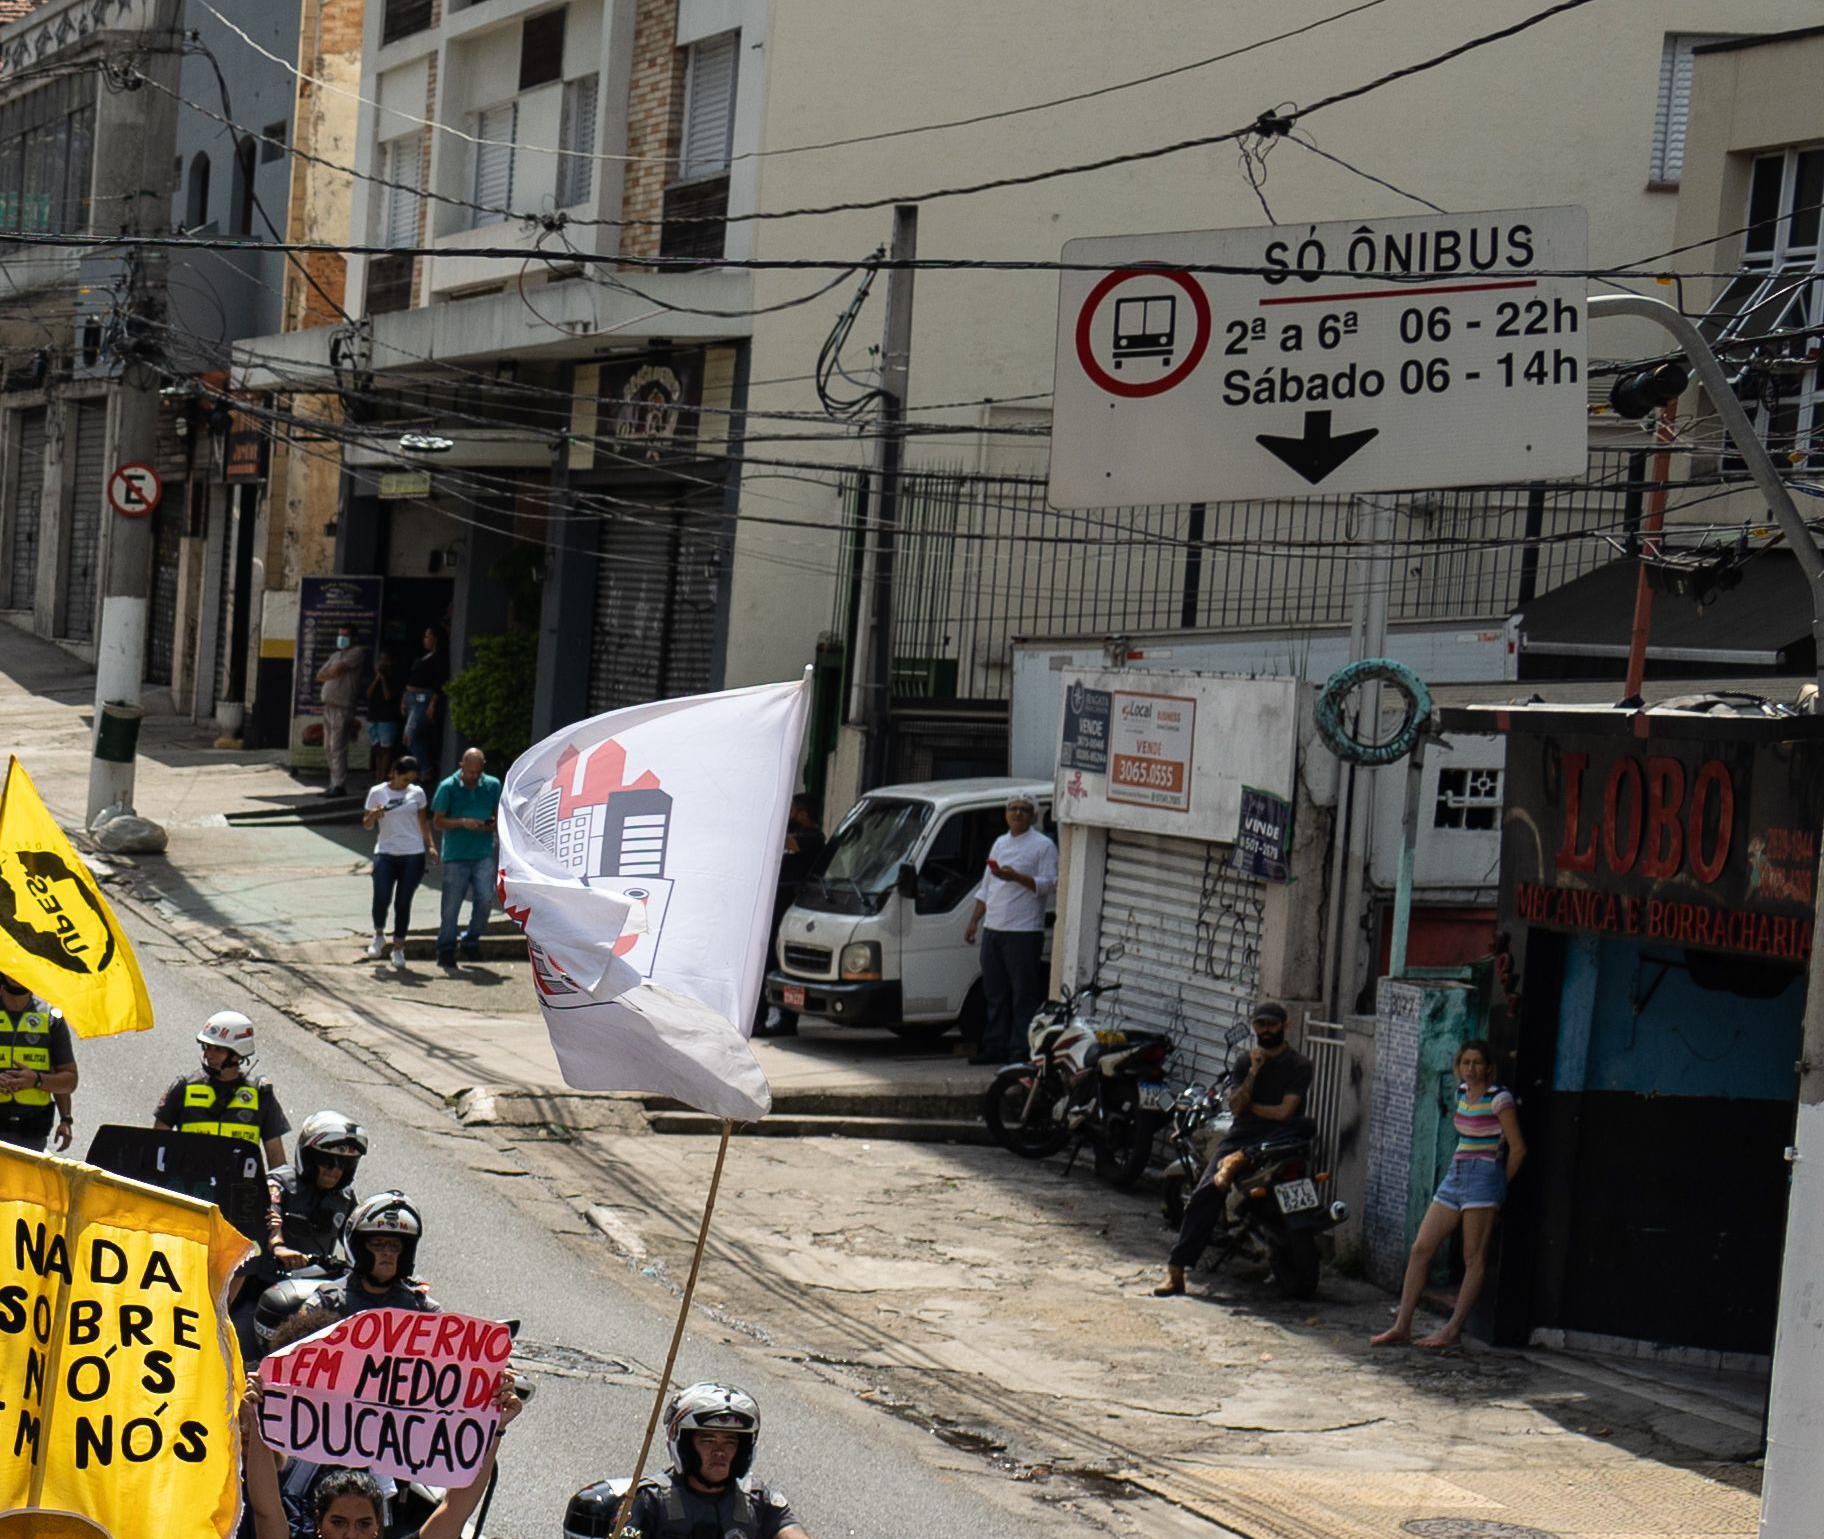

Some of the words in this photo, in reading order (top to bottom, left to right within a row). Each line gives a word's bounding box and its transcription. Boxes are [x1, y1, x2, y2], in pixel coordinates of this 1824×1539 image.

[1263, 225, 1326, 285] SÓ
[1348, 224, 1535, 275] ÔNIBUS
[1225, 316, 1266, 355] 2ª
[1280, 322, 1303, 352] a
[1317, 311, 1358, 350] 6ª
[1399, 306, 1451, 344] 06
[1495, 298, 1578, 338] 22h
[1222, 363, 1384, 406] Sábado
[1399, 357, 1451, 395] 06
[1497, 349, 1578, 388] 14h
[1244, 818, 1280, 840] VENDE
[1556, 752, 1733, 884] LOBO
[1648, 899, 1812, 960] BORRACHARIA
[15, 1217, 182, 1294] NADA
[323, 1312, 513, 1363] GOVERNO
[23, 1344, 176, 1407] NÓS
[269, 1347, 344, 1390] TEM
[354, 1354, 461, 1408] MEDO
[75, 1402, 209, 1470] NÓS
[258, 1390, 497, 1475] EDUCAÇÃO!
